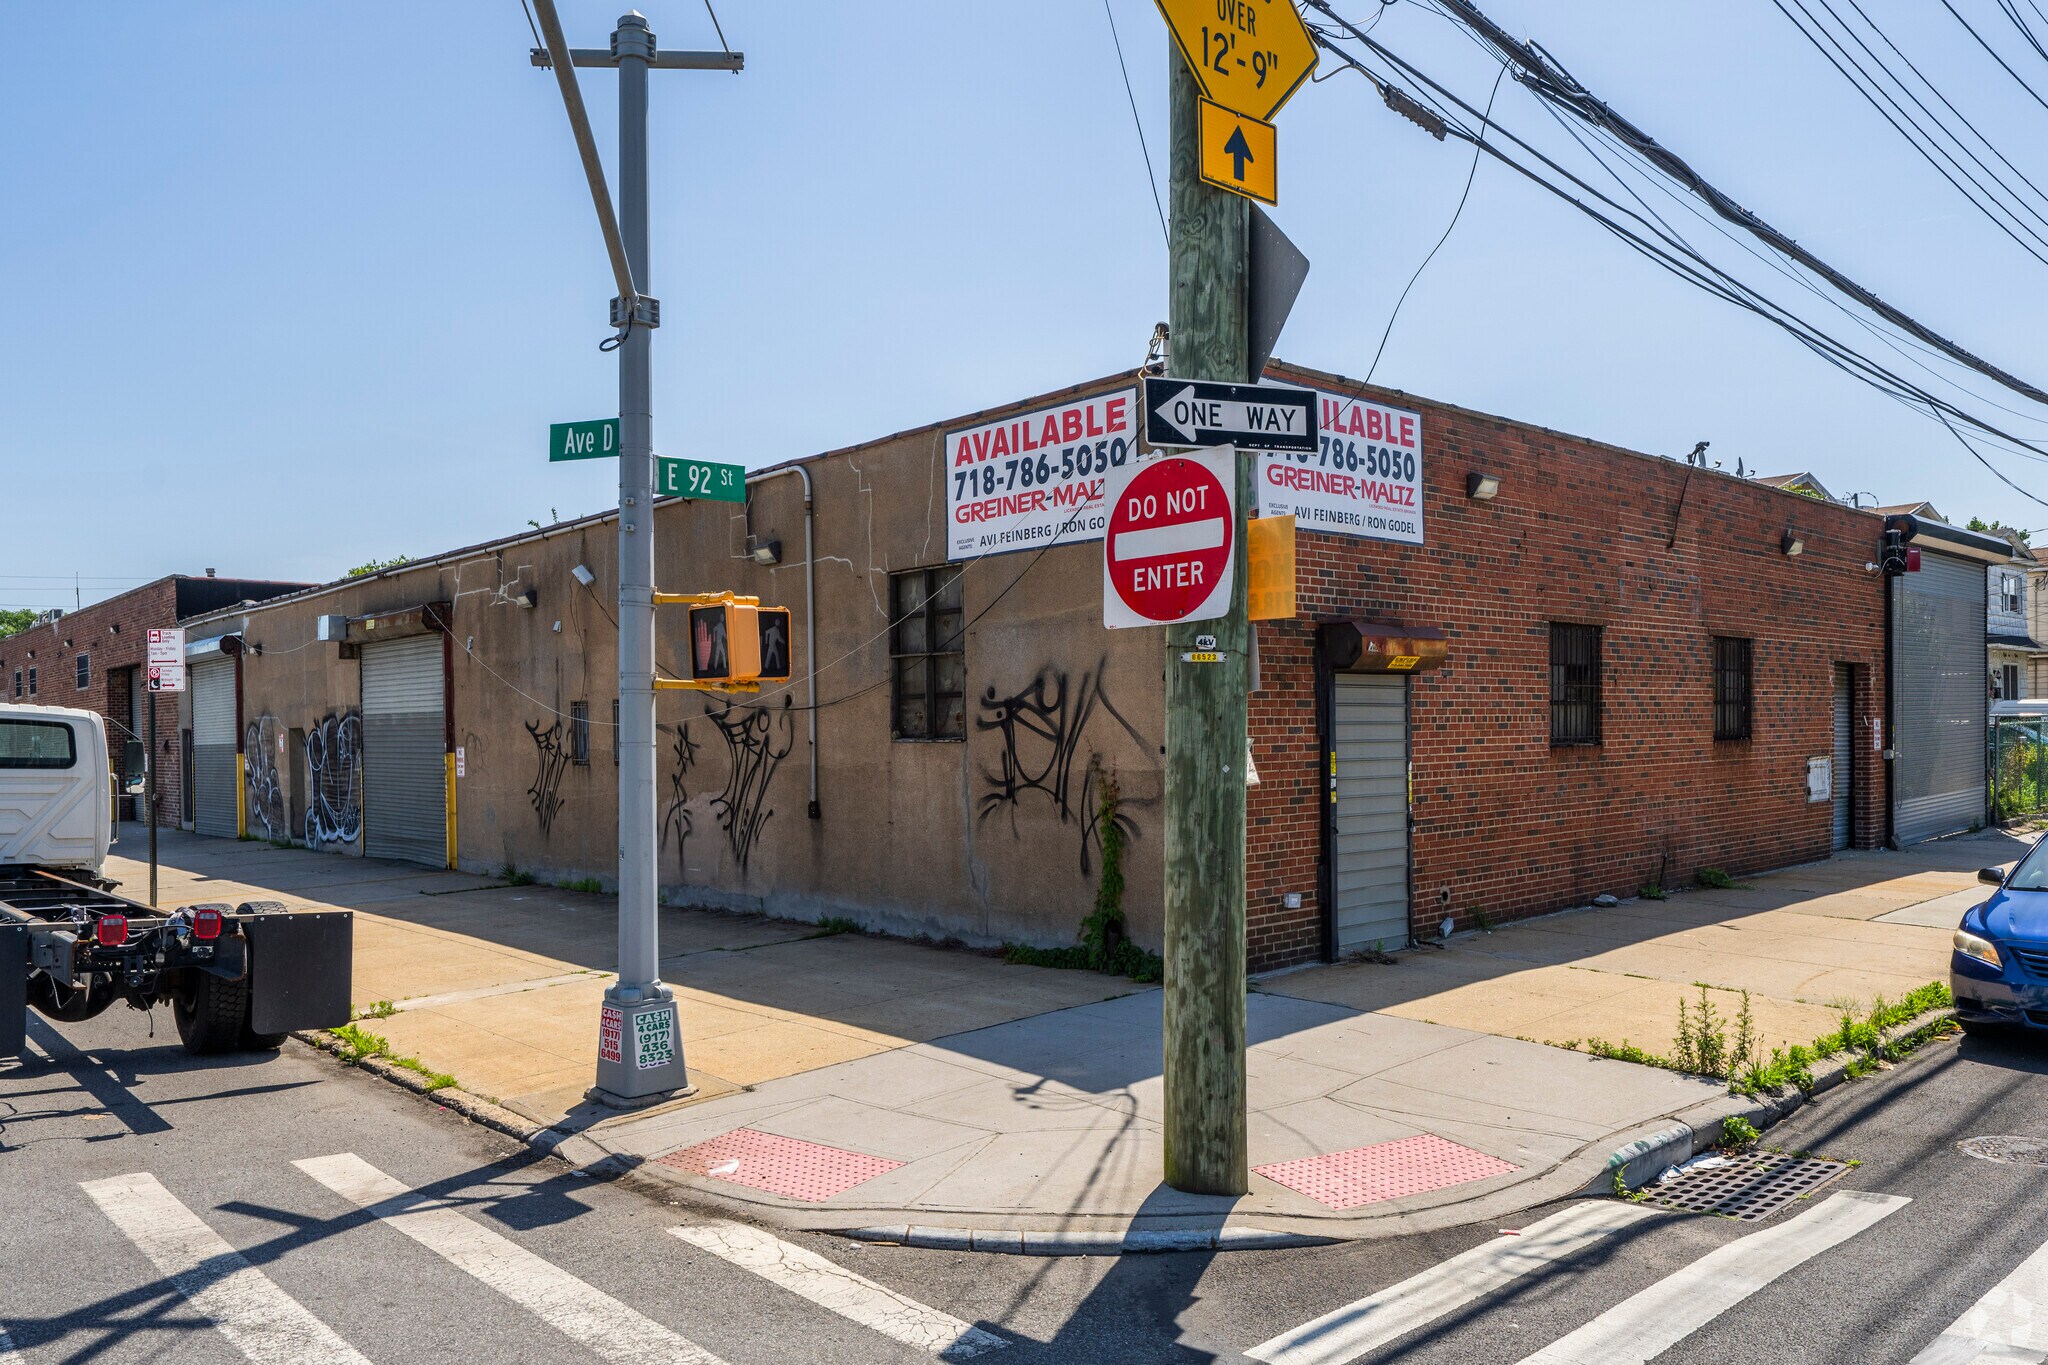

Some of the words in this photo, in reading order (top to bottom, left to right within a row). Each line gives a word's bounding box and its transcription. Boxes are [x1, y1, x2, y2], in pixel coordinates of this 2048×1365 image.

[1217, 0, 1256, 37] OVER
[1174, 401, 1222, 427] ONE
[1247, 406, 1296, 431] WAY
[1320, 398, 1415, 448] ILABLE
[564, 427, 594, 455] Ave
[603, 424, 613, 451] D
[955, 397, 1127, 467] AVAILABLE
[668, 463, 678, 491] E
[688, 465, 712, 494] 92
[720, 468, 733, 487] St
[955, 437, 1127, 501] 718-786-5050
[1267, 464, 1415, 507] GREINER-MALTZ
[1128, 495, 1157, 522] DO
[1166, 485, 1208, 516] NOT
[980, 533, 997, 547] AVI
[1000, 524, 1051, 544] FEINBERG
[1062, 519, 1085, 534] RON
[1295, 506, 1310, 520] AVI
[1314, 508, 1360, 526] FEINBERG
[1368, 516, 1386, 529] RON
[1388, 519, 1416, 534] GODEL
[1134, 561, 1203, 592] ENTER
[1198, 637, 1214, 646] 4kV
[1191, 653, 1217, 661] 86523
[603, 1028, 620, 1040] (917)
[638, 1025, 644, 1033] 4
[639, 1030, 670, 1044] (917)
[601, 1048, 621, 1062] 6499
[604, 1039, 618, 1051] 515
[639, 1049, 673, 1064] 8323
[642, 1040, 668, 1053] 436
